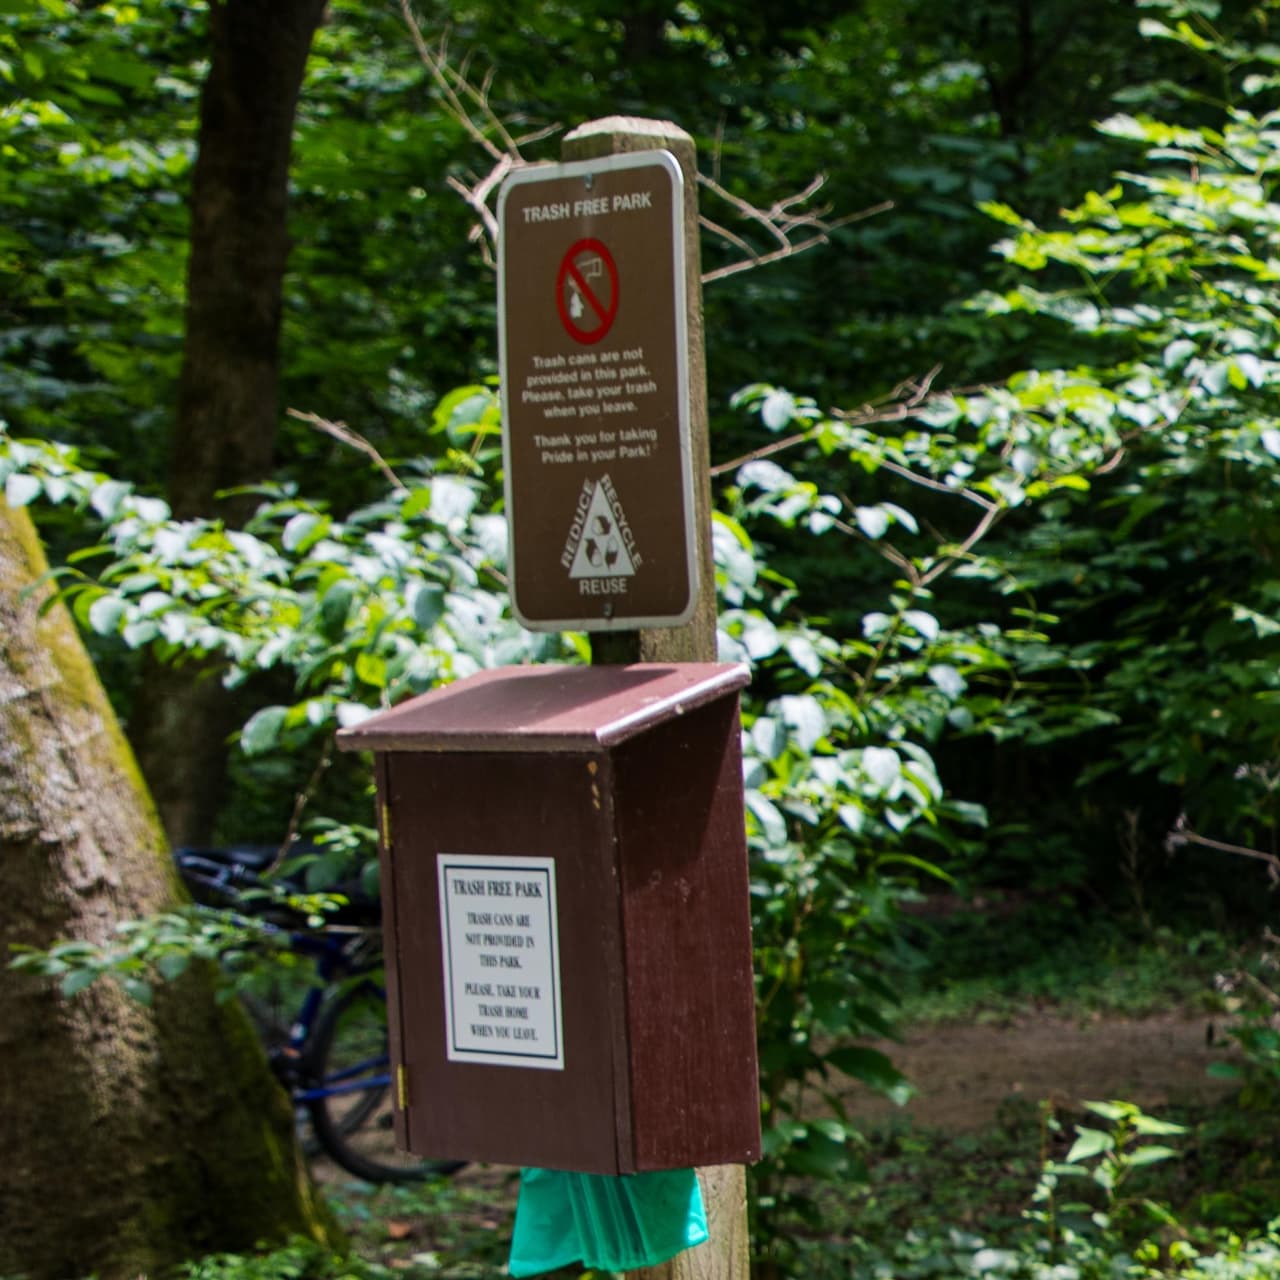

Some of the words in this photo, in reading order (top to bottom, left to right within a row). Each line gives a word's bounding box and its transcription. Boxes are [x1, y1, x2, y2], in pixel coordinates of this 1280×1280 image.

[522, 202, 570, 223] TRASH
[574, 197, 609, 217] FREE
[613, 192, 652, 212] PARK
[533, 354, 566, 368] Trash
[568, 353, 597, 366] cans
[600, 351, 620, 363] are
[623, 347, 643, 360] not
[527, 371, 578, 388] provided
[580, 369, 592, 381] in
[595, 367, 617, 380] this
[620, 365, 651, 380] park.
[567, 386, 594, 400] take
[597, 385, 622, 399] your
[626, 379, 657, 394] trash
[544, 405, 576, 418] when
[578, 404, 600, 418] you
[602, 401, 637, 413] leave.
[534, 434, 571, 448] Thank
[575, 434, 597, 447] you
[600, 430, 616, 443] for
[620, 428, 657, 442] taking
[541, 450, 573, 464] Pride
[576, 448, 588, 462] in
[590, 448, 616, 463] your
[619, 444, 650, 459] Park!
[561, 478, 595, 569] REDUCE
[600, 473, 643, 571] RECYCLE
[579, 578, 628, 595] REUSE
[453, 879, 486, 896] TRASH
[487, 880, 513, 897] FREE
[514, 881, 543, 898] PARK
[467, 912, 493, 926] TRASH
[493, 912, 514, 926] CANS
[515, 914, 531, 928] ARE
[465, 933, 482, 945] NOT
[483, 934, 524, 948] PROVIDED
[525, 936, 536, 949] IN
[479, 954, 498, 967] THIS
[496, 984, 517, 999] TAKE
[518, 986, 541, 1000] YOUR
[478, 1004, 503, 1018] TRASH
[504, 1006, 529, 1020] HOME
[470, 1024, 494, 1038] WHEN
[495, 1026, 511, 1039] YOU
